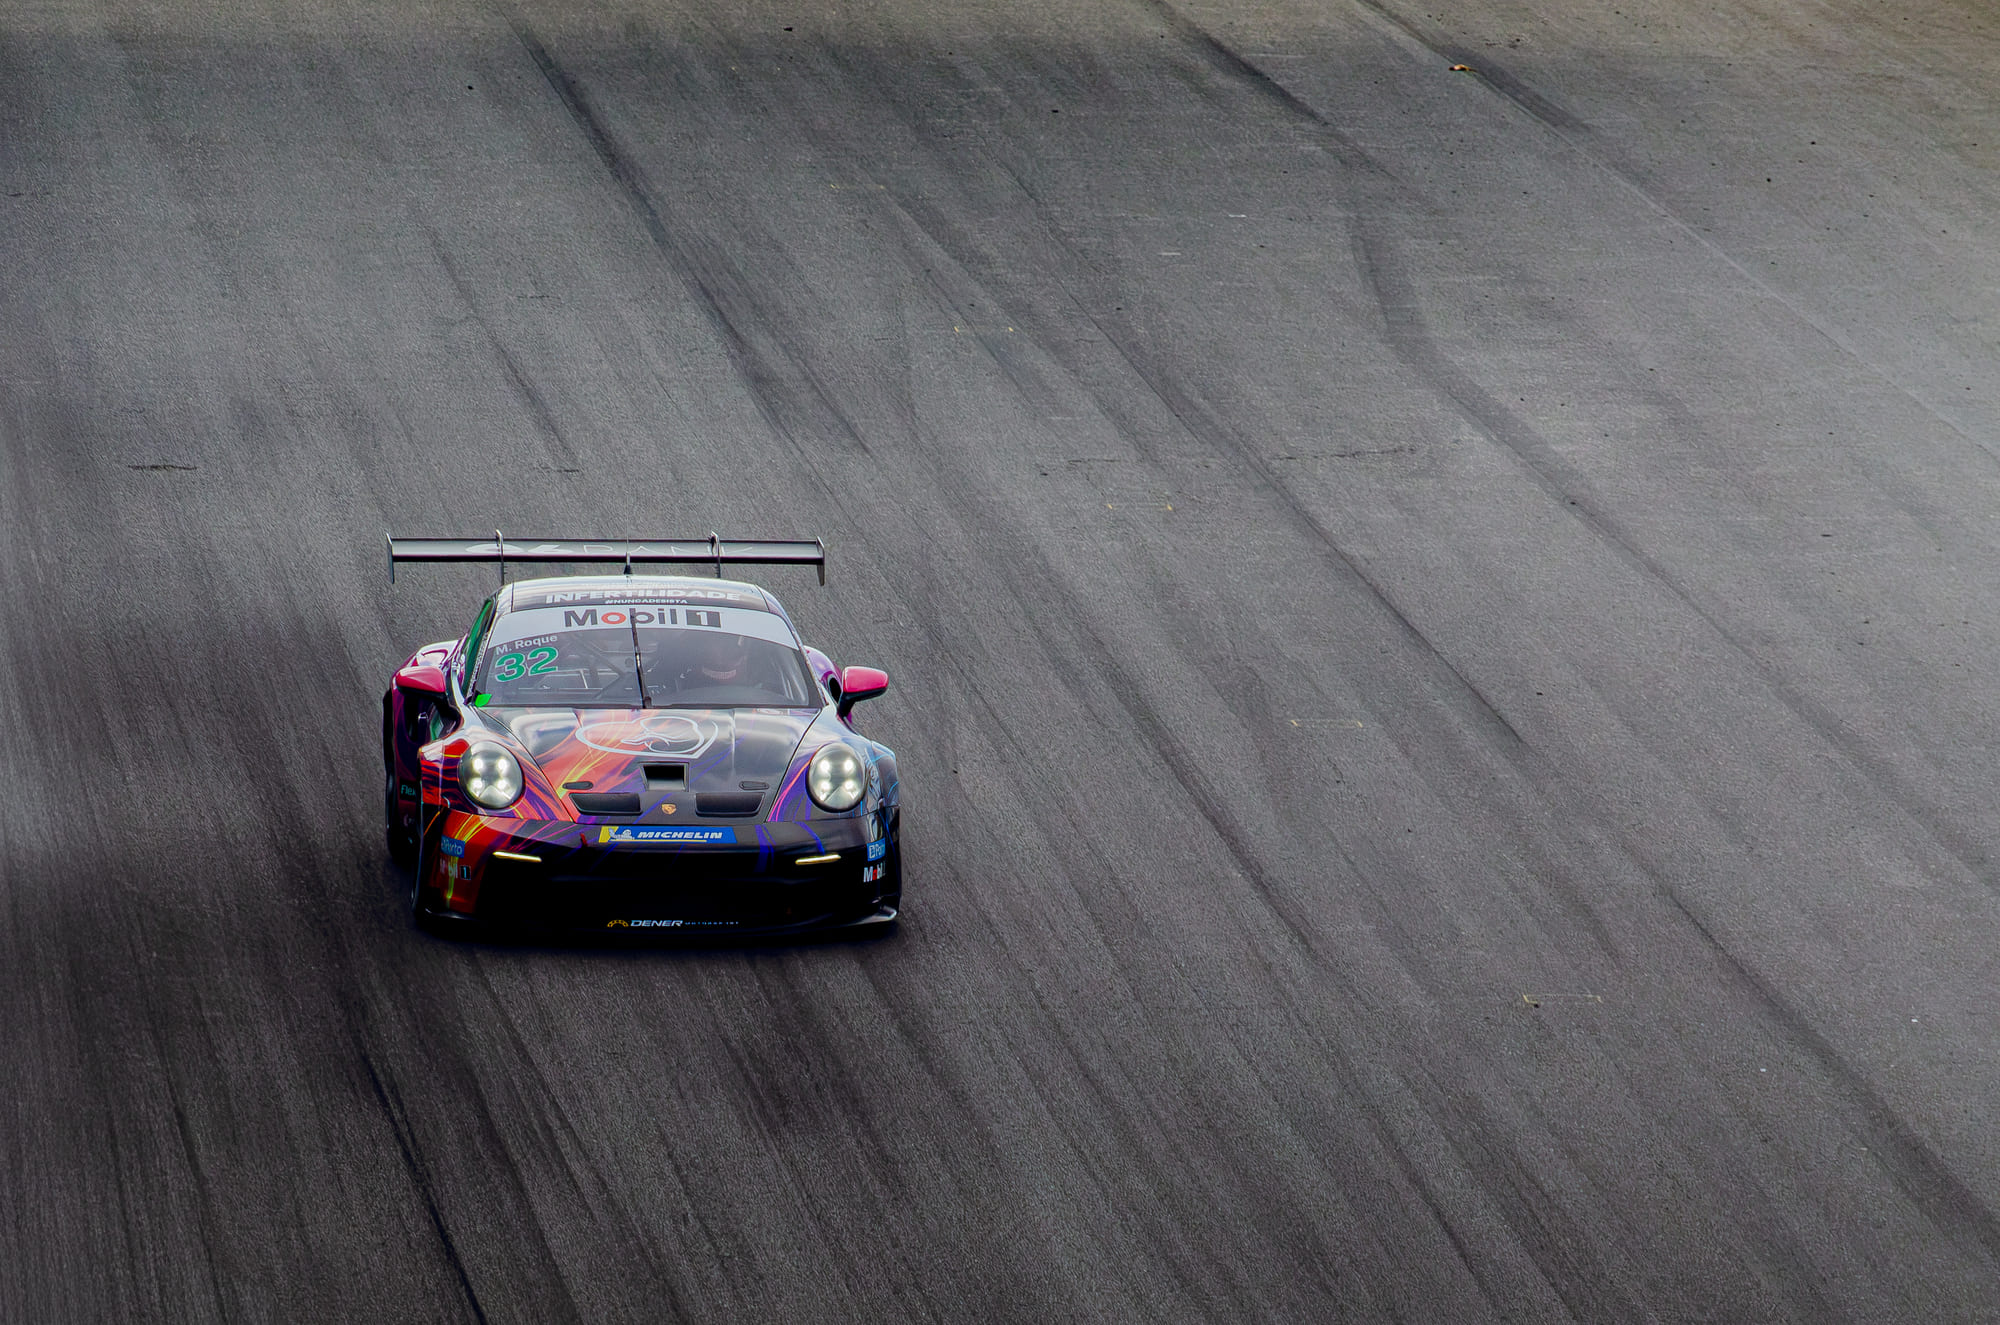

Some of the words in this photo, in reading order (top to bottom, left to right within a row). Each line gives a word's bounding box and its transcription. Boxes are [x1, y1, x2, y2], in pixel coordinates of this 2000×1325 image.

[545, 589, 740, 604] INFERTILIDADE
[564, 608, 678, 628] Mobil
[496, 644, 512, 655] M.
[514, 635, 558, 650] Roque
[495, 646, 559, 682] 32
[637, 831, 723, 840] MICHELIN
[630, 919, 684, 927] DENER
